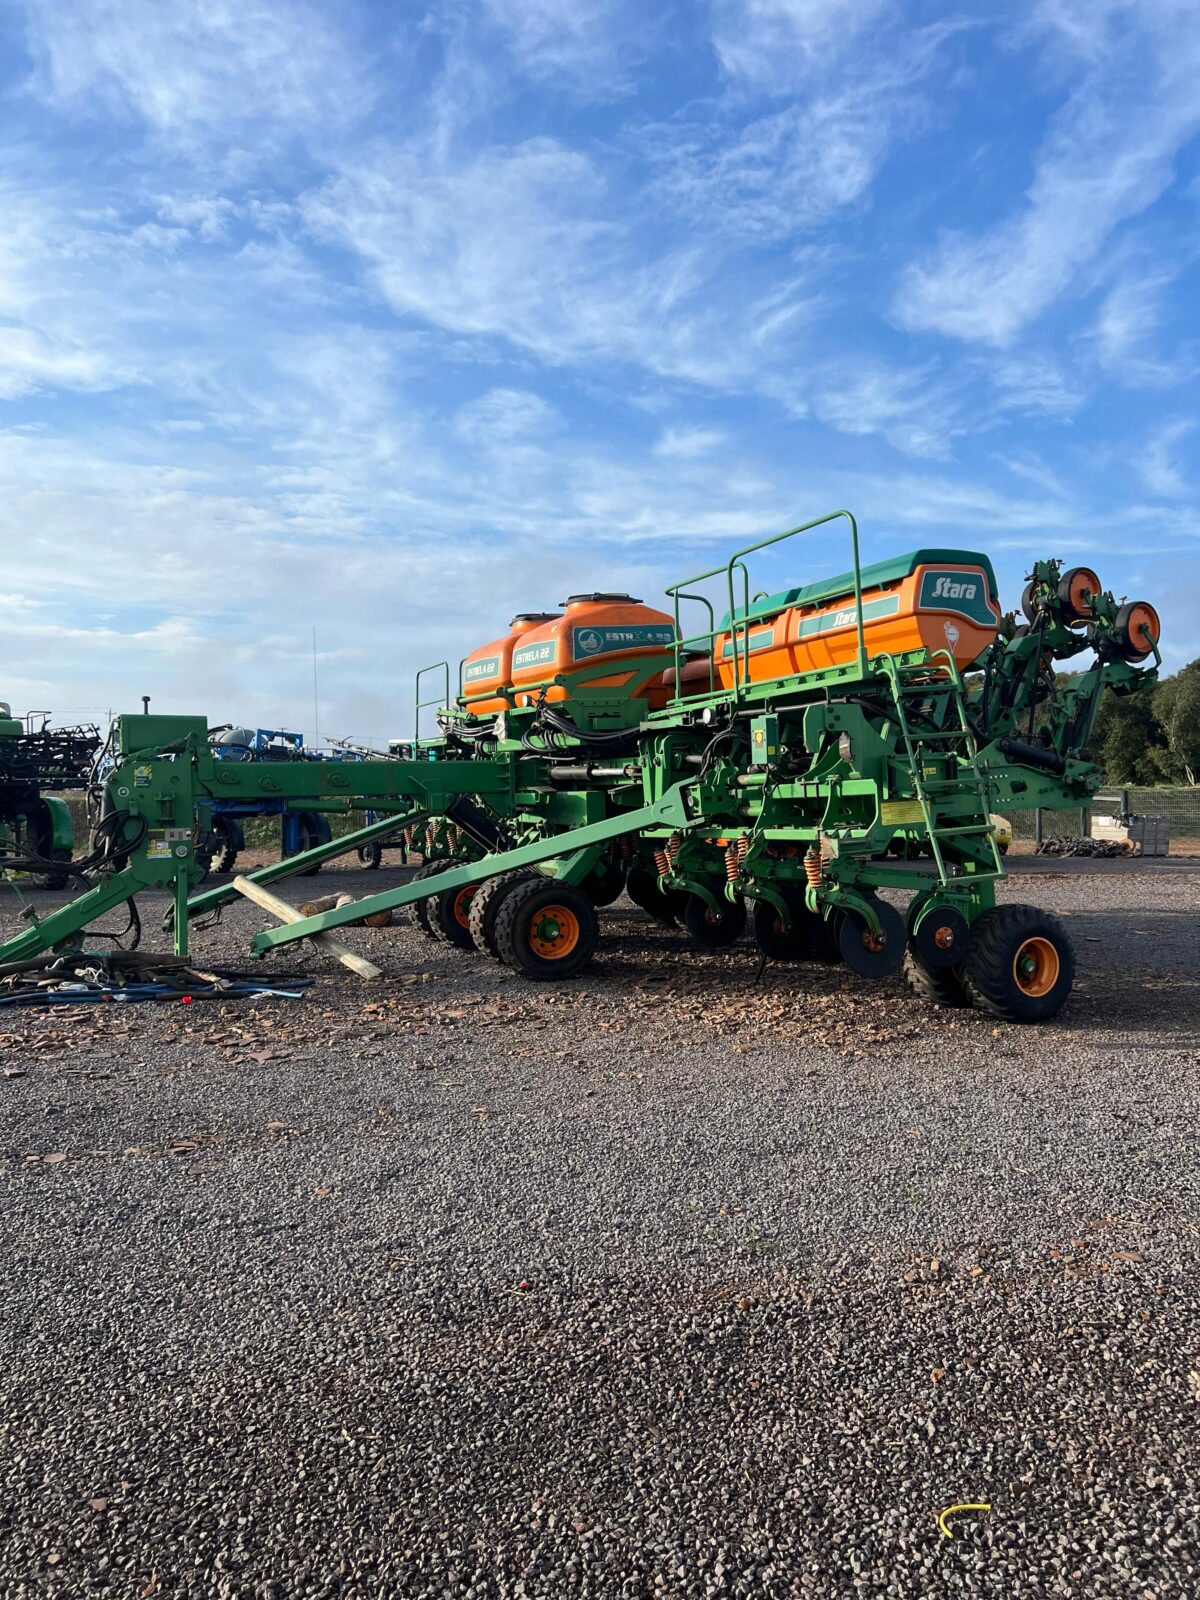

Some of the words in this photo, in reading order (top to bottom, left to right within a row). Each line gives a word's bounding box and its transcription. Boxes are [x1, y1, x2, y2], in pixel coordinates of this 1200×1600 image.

[932, 578, 976, 599] Stara
[833, 611, 857, 626] Stara
[516, 650, 539, 664] ESTRELA
[540, 647, 549, 659] 22
[467, 664, 486, 677] ESTRELA
[487, 663, 495, 672] 22
